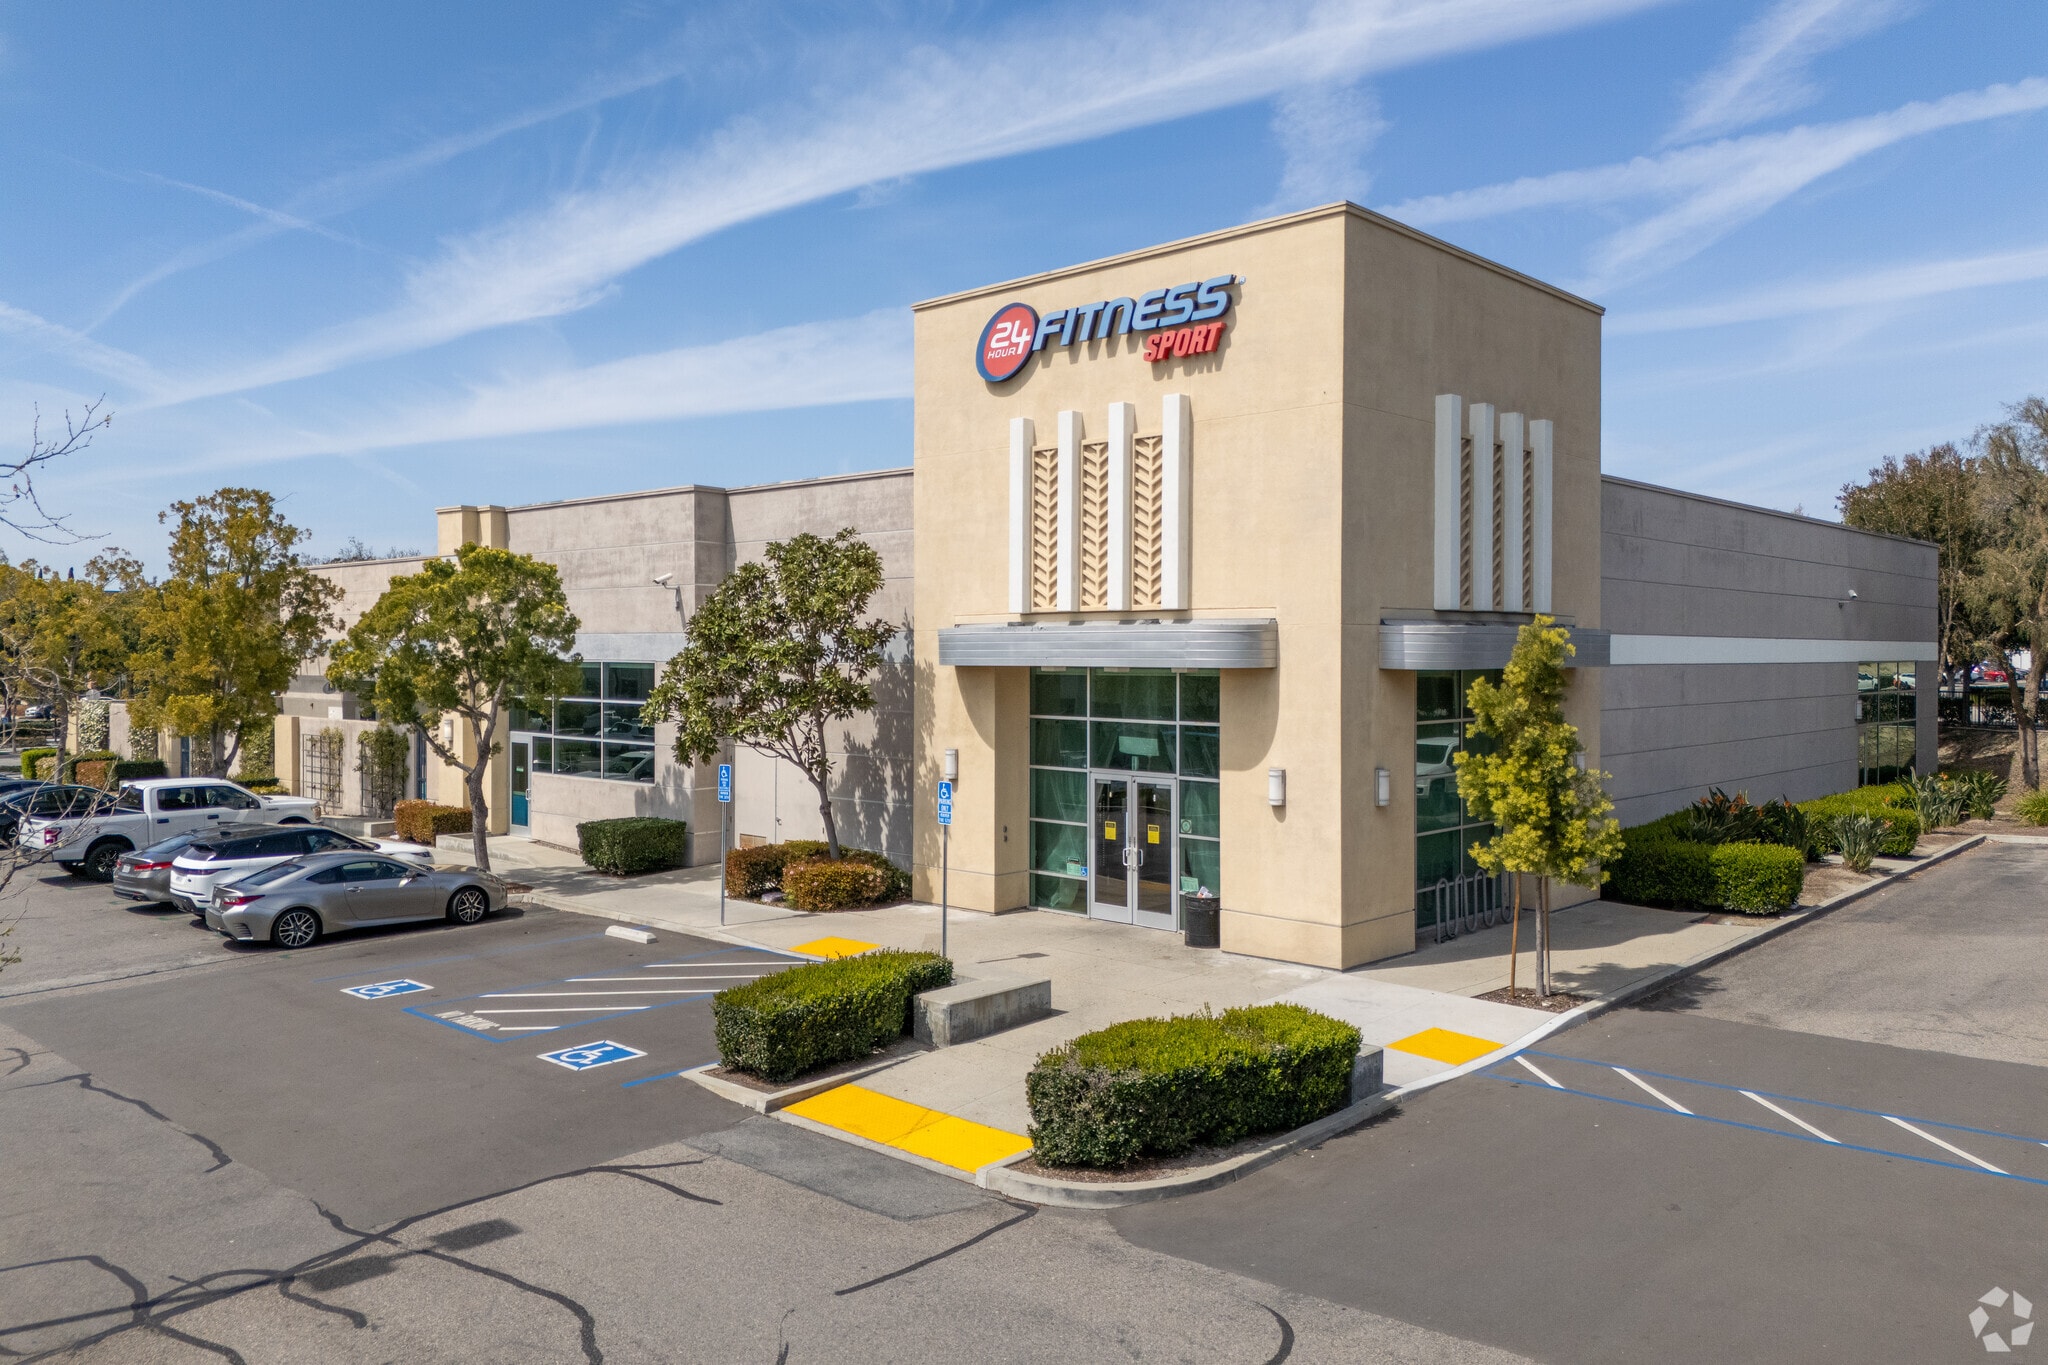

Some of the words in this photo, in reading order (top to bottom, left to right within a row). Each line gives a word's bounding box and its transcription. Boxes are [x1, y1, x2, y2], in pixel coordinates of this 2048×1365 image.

[1032, 274, 1237, 352] FITNESS
[987, 347, 1016, 360] HOUR
[990, 319, 1031, 355] 24
[1143, 321, 1226, 363] SPORT
